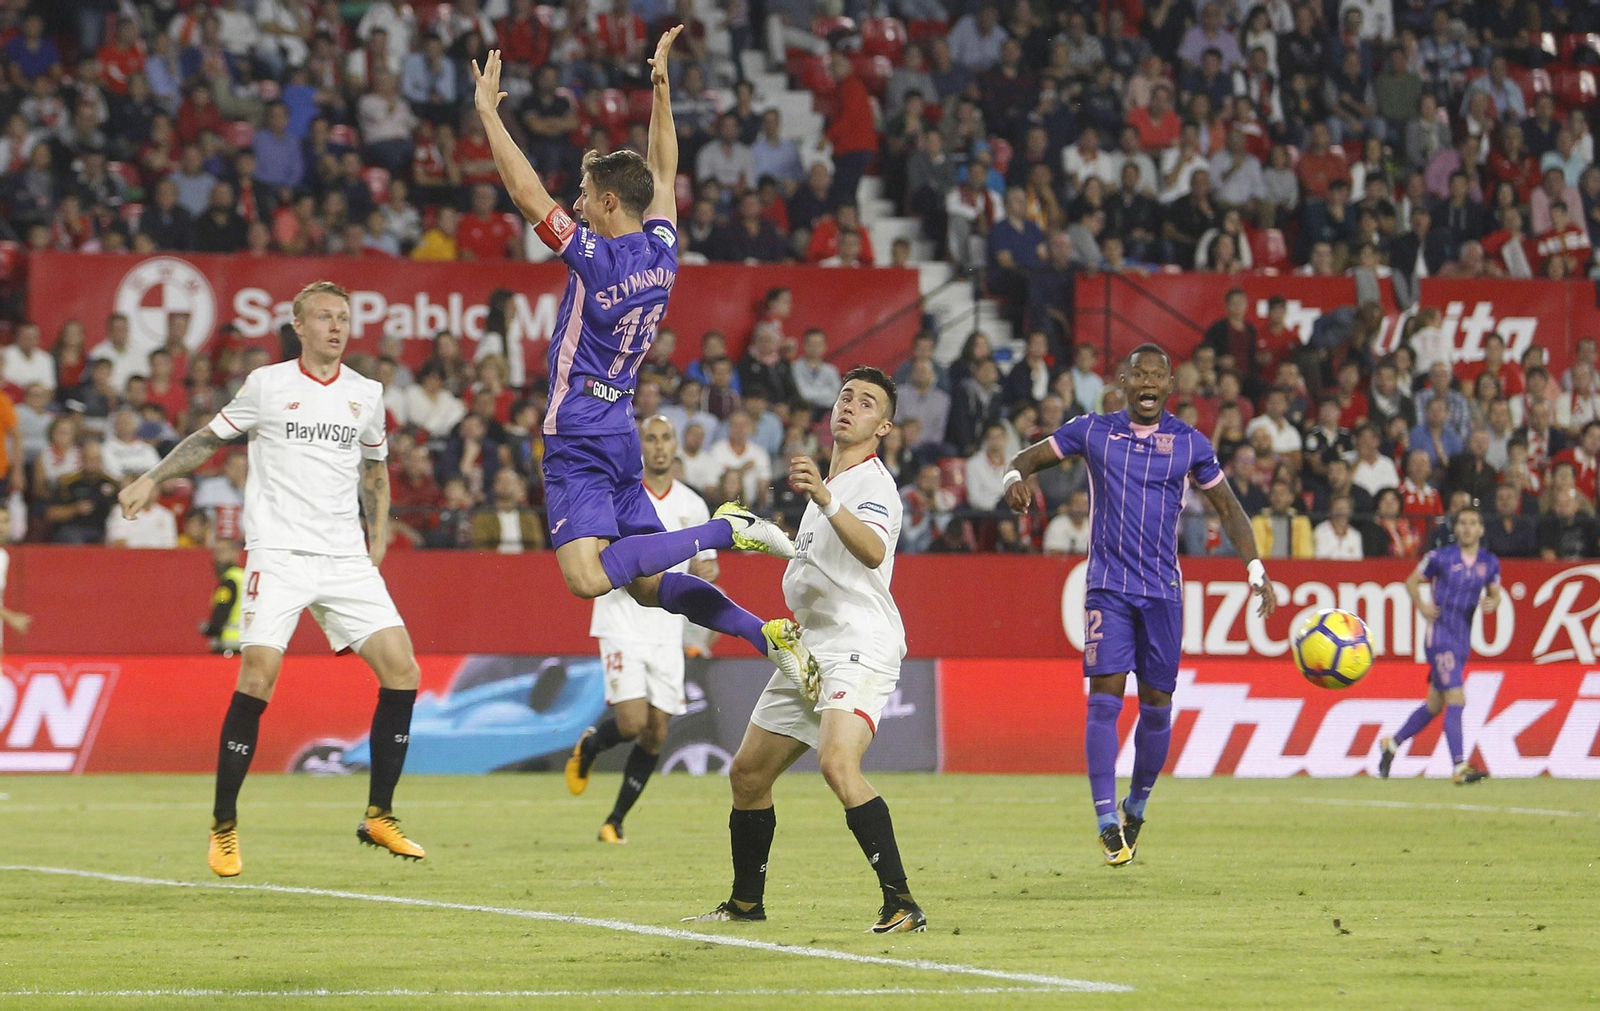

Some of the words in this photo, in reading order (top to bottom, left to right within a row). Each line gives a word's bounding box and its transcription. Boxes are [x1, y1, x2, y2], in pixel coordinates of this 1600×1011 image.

[595, 267, 676, 310] SZYMANOW
[233, 287, 304, 339] Sa
[608, 303, 665, 379] 11
[286, 422, 358, 444] PlayWSOP
[247, 570, 261, 601] 4
[1532, 563, 1600, 666] R
[227, 740, 249, 755] SFC
[394, 734, 410, 744] SF
